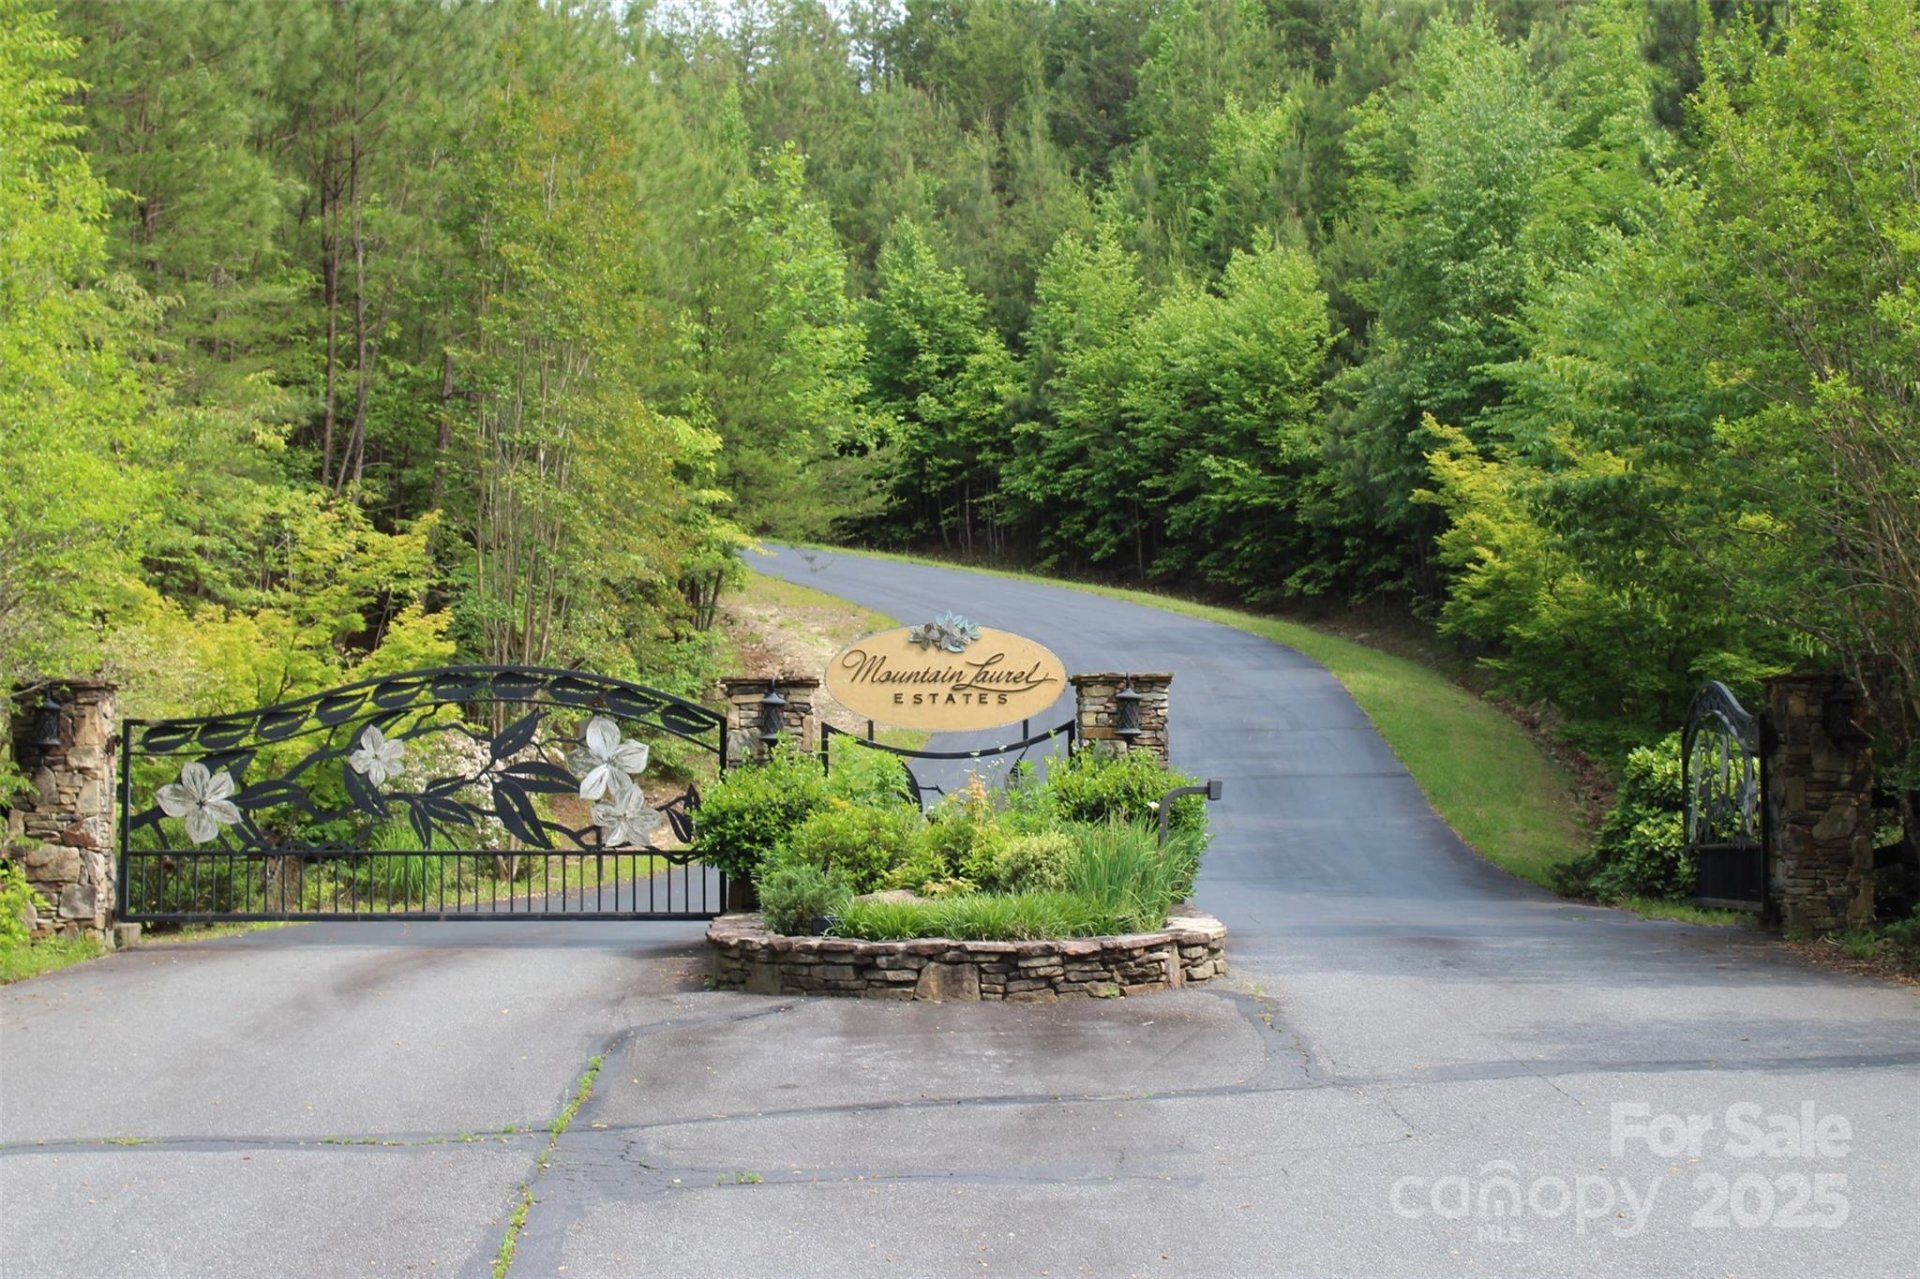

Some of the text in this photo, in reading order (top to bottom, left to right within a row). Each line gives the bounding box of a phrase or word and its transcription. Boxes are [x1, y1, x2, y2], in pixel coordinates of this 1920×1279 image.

[842, 649, 1058, 692] Mountain Laurel
[893, 692, 1008, 705] ESTATES
